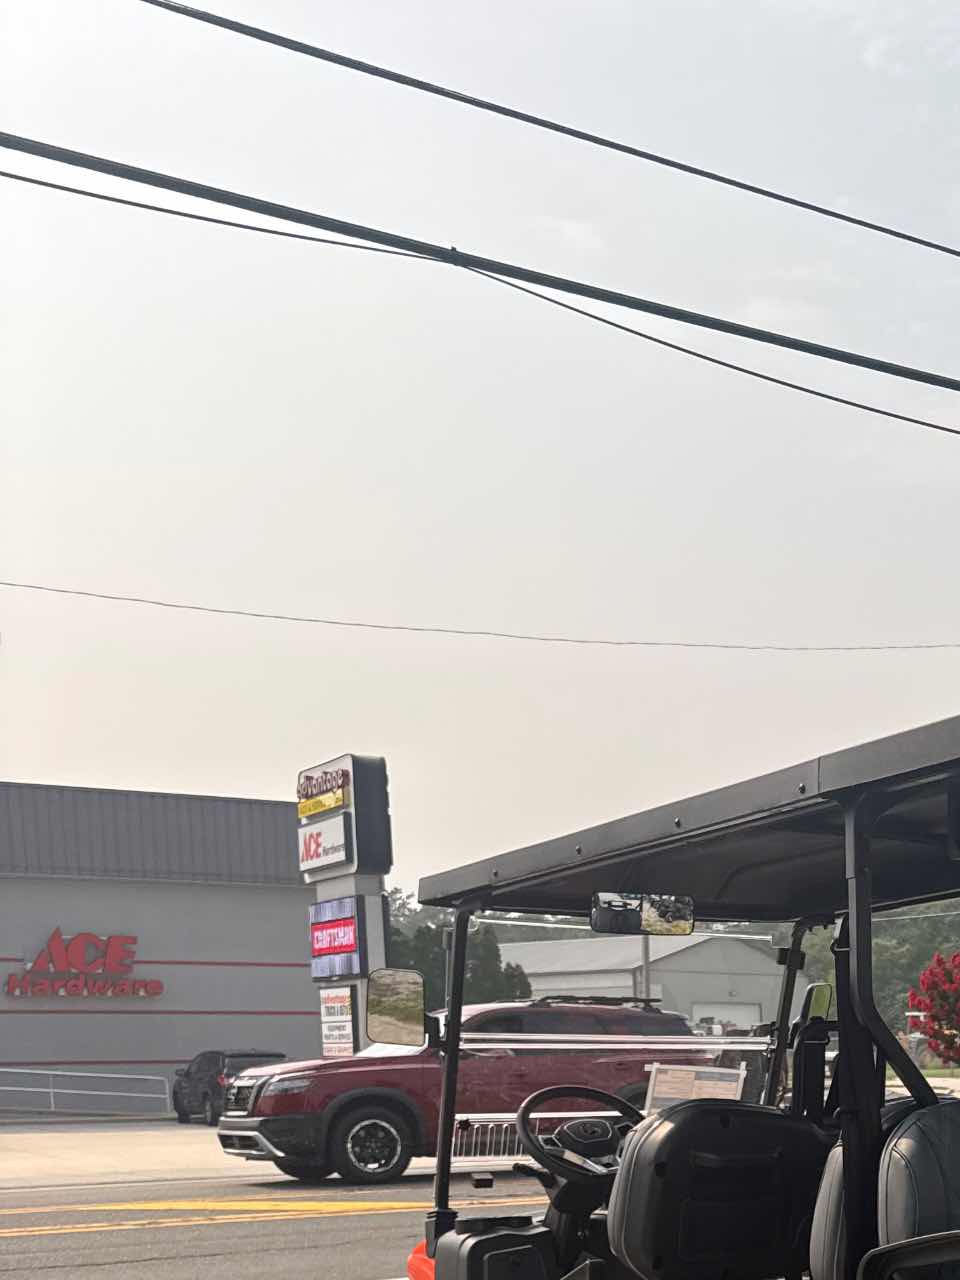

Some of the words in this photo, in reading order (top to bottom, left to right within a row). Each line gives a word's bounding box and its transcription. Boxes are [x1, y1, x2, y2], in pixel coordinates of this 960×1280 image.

[303, 831, 322, 863] ACE
[29, 926, 138, 973] ACE
[7, 973, 163, 997] Hardware
